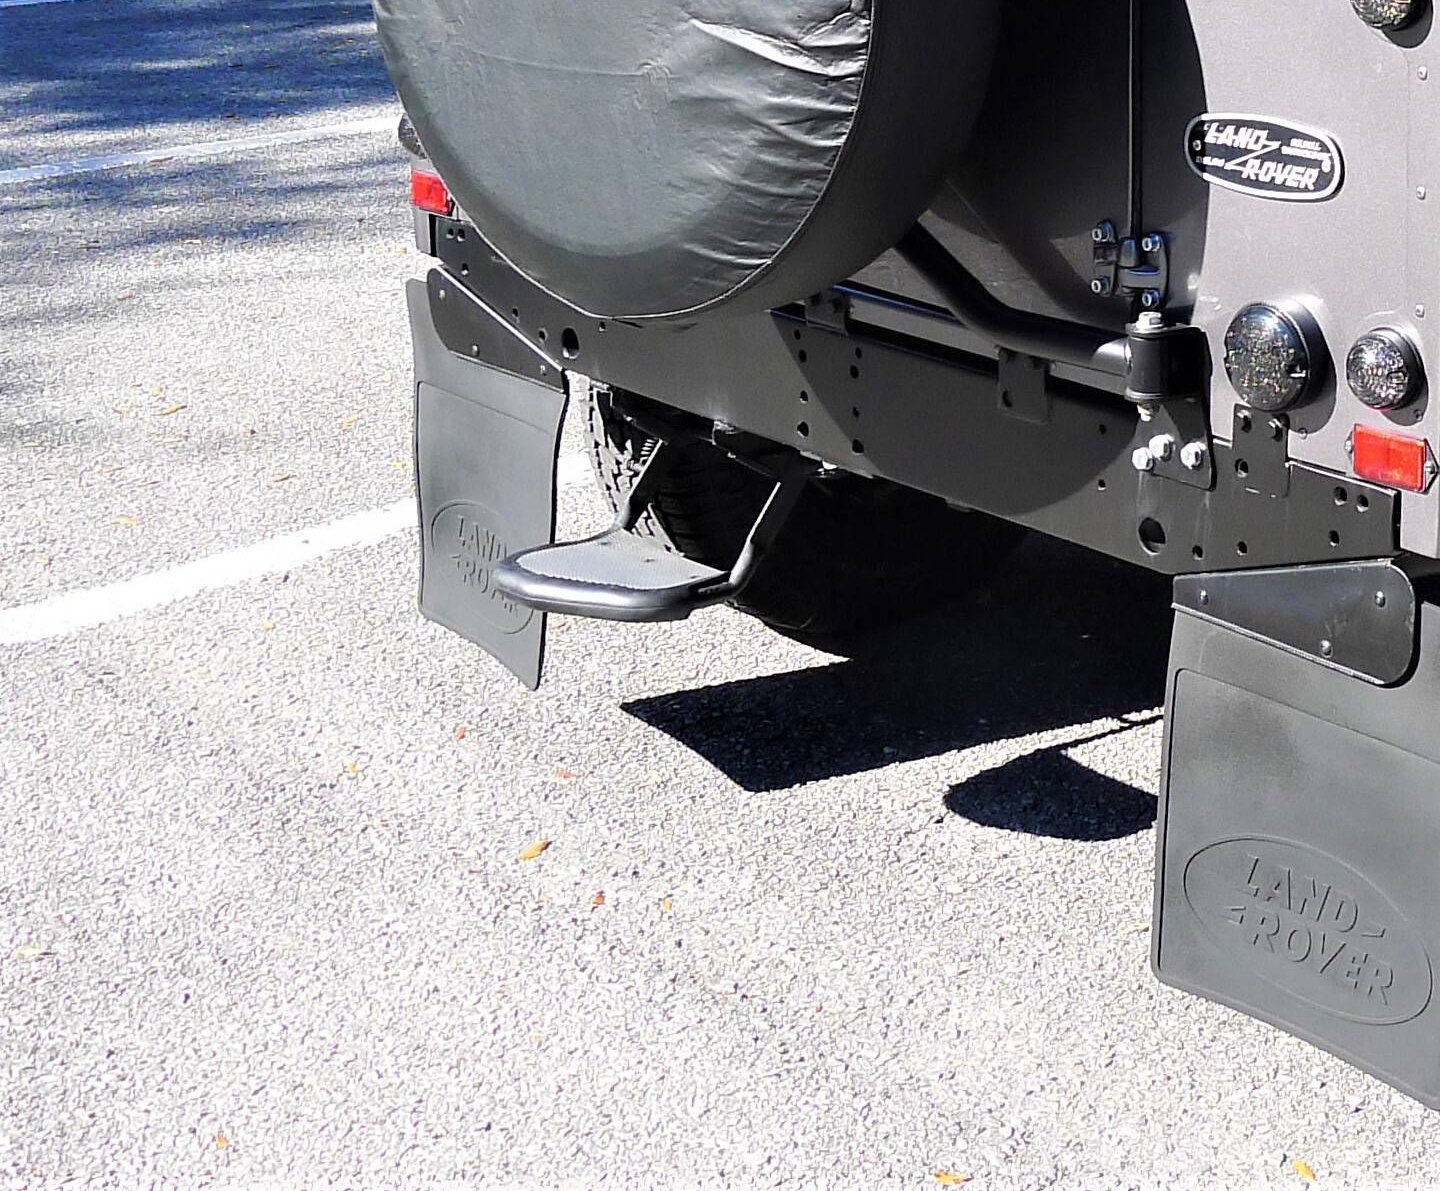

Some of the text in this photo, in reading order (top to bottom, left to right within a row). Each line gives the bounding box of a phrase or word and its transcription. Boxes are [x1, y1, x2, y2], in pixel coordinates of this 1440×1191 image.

[1204, 122, 1269, 150] LAND
[1242, 158, 1320, 190] ROVER
[1242, 855, 1358, 933] LAND
[1250, 911, 1395, 1006] ROVER
